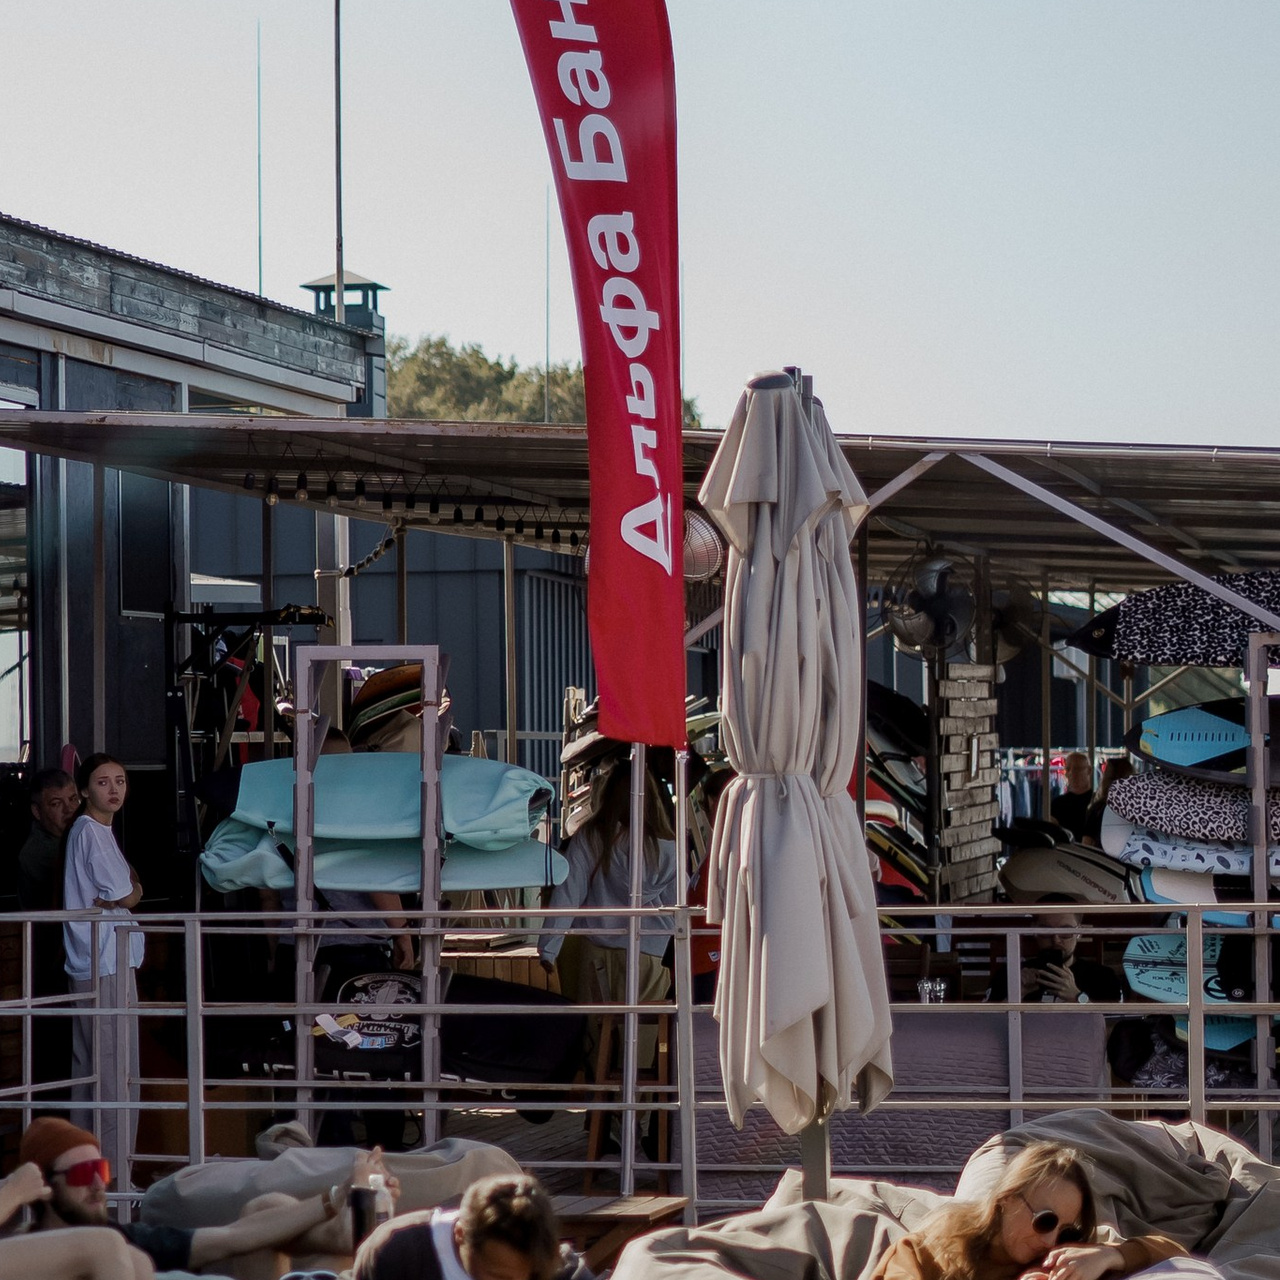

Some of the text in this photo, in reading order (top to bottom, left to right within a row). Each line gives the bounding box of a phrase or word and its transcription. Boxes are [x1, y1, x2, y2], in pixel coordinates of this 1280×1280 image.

[587, 211, 673, 575] Альфа
[1056, 860, 1117, 902] ТОЛЬКО ПОПРОБУЙ
[343, 1022, 410, 1034] DEPARTMEN
